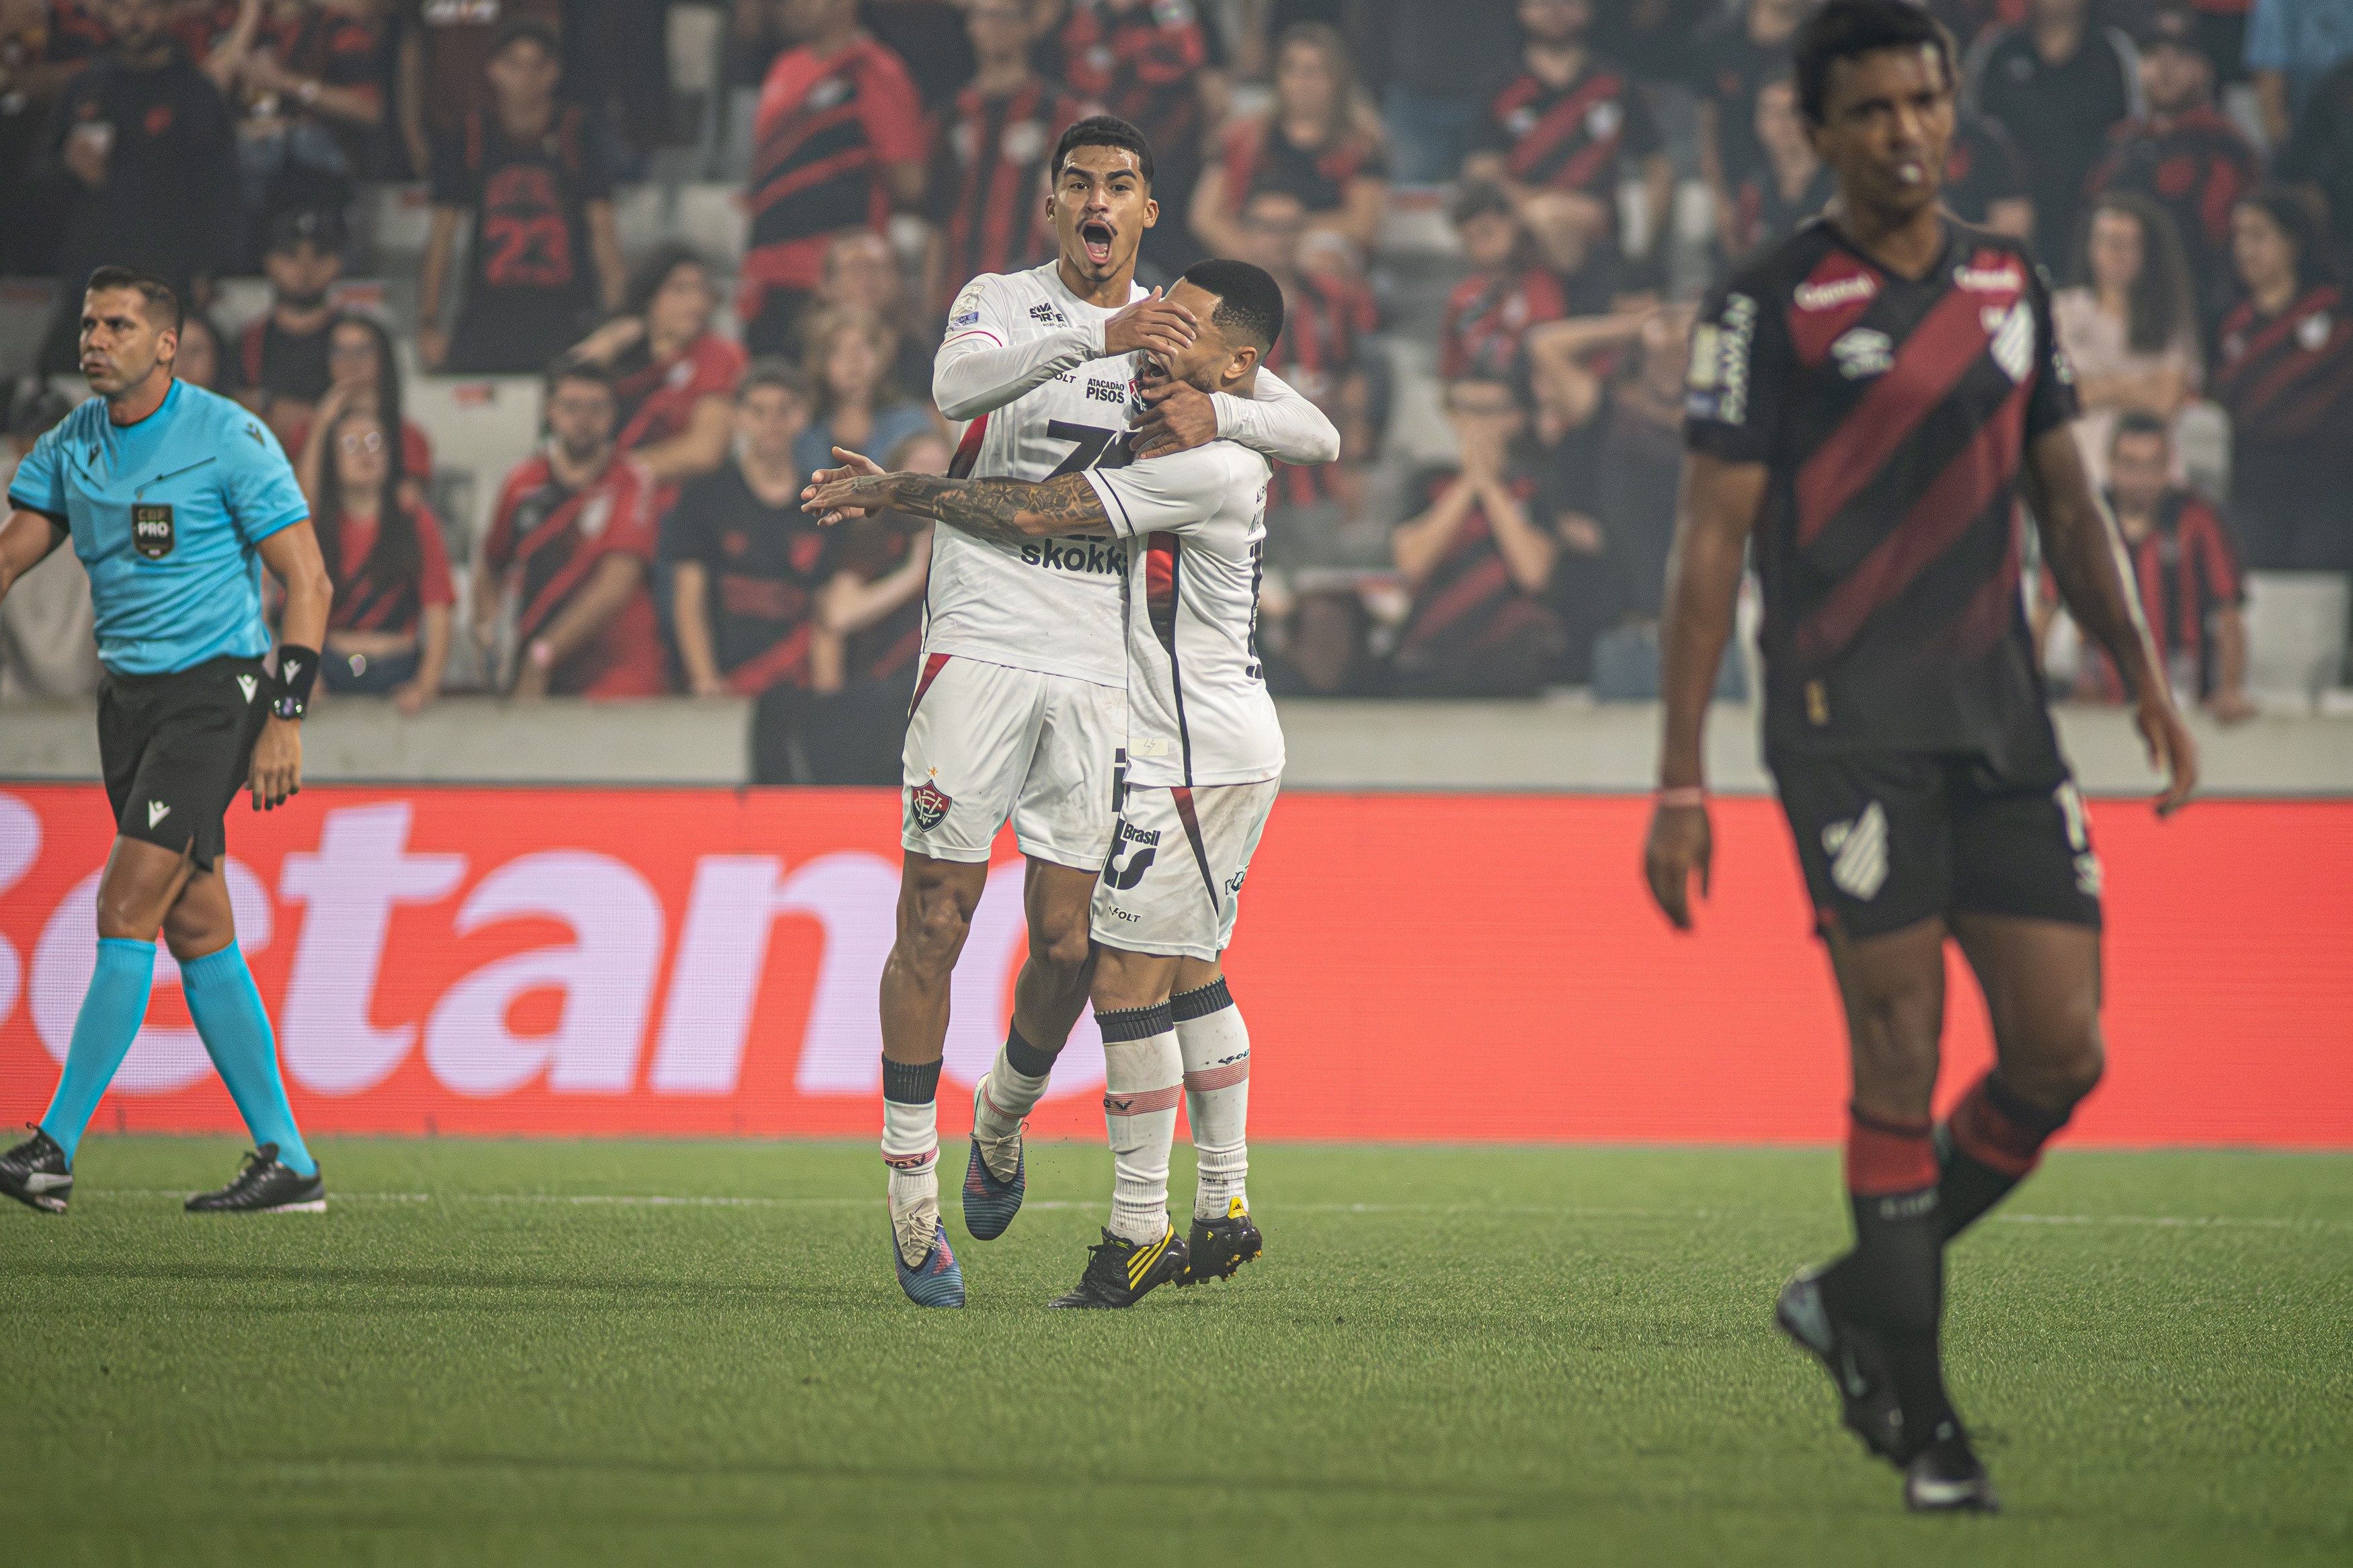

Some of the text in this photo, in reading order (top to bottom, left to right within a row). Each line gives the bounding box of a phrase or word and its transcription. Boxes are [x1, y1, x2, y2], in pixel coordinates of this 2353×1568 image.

[1054, 372, 1076, 384] OLT
[1087, 378, 1125, 391] ATACADÃO
[1086, 387, 1125, 404] PISOS
[138, 522, 169, 537] PRO
[1122, 823, 1161, 847] Brasil
[1109, 905, 1141, 923] VOLT
